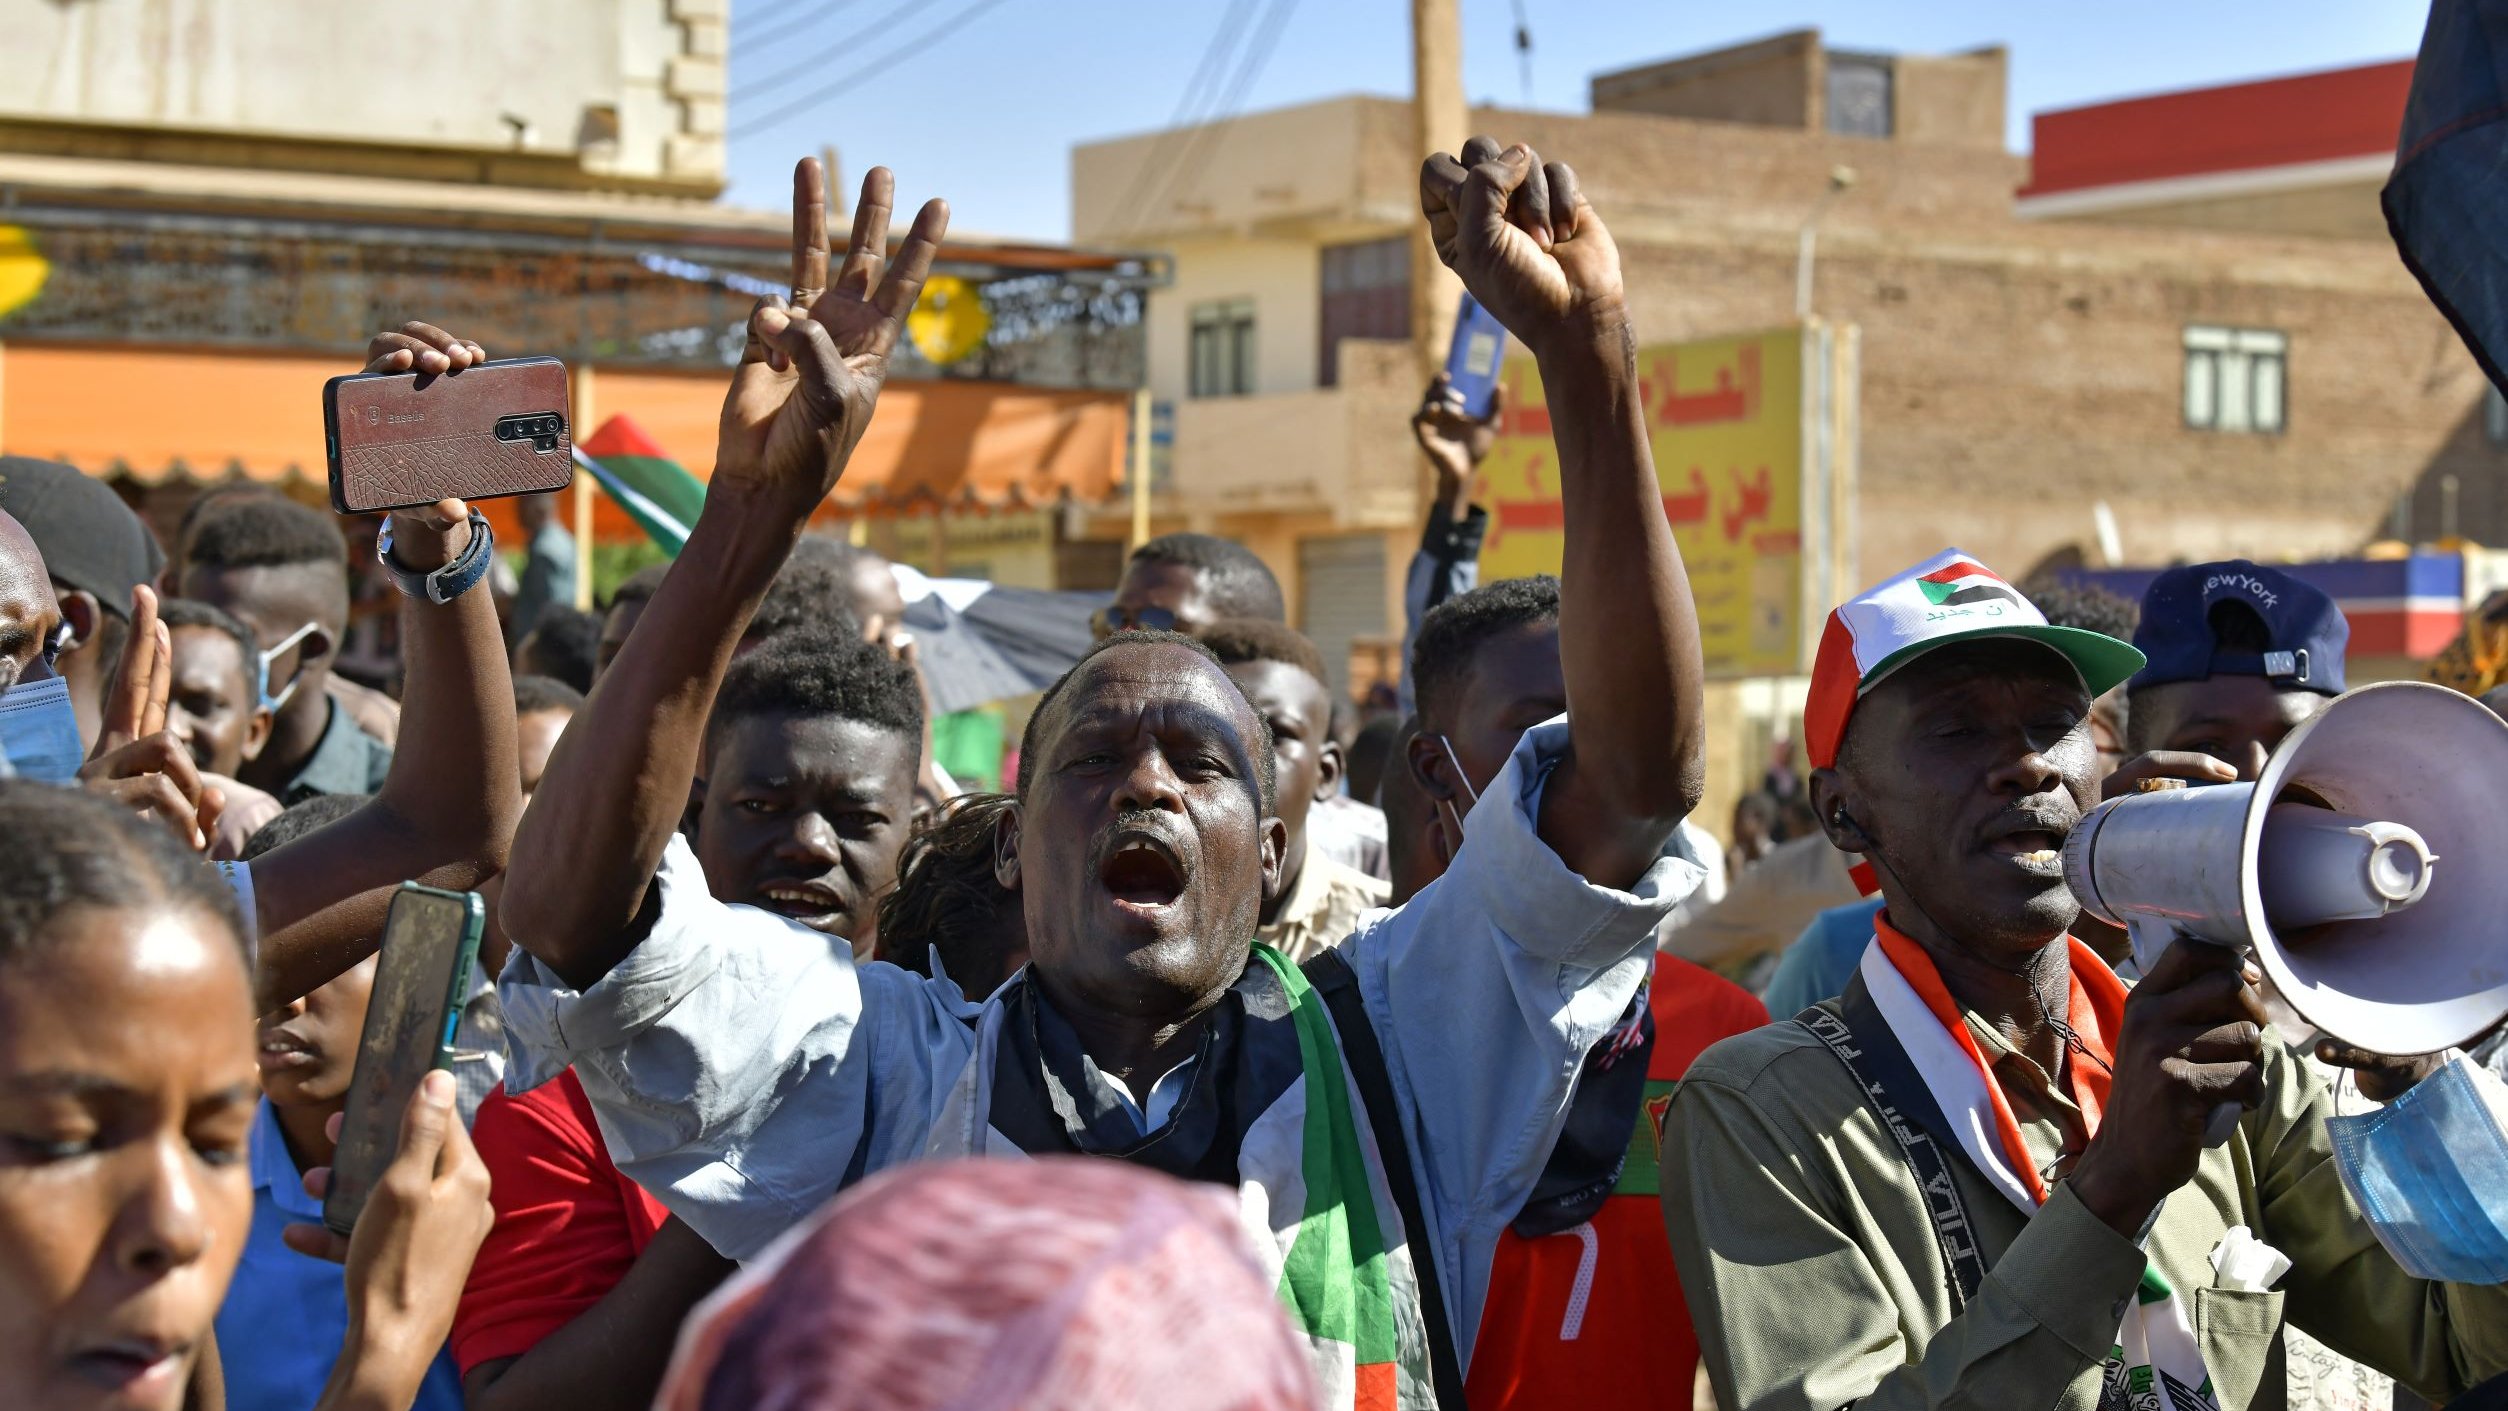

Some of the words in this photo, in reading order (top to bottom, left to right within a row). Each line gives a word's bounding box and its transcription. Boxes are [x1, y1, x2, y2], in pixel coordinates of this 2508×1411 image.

[1811, 1015, 1863, 1060] FILA
[1927, 1171, 1974, 1260] FILA
[1551, 1221, 1599, 1340] 7
